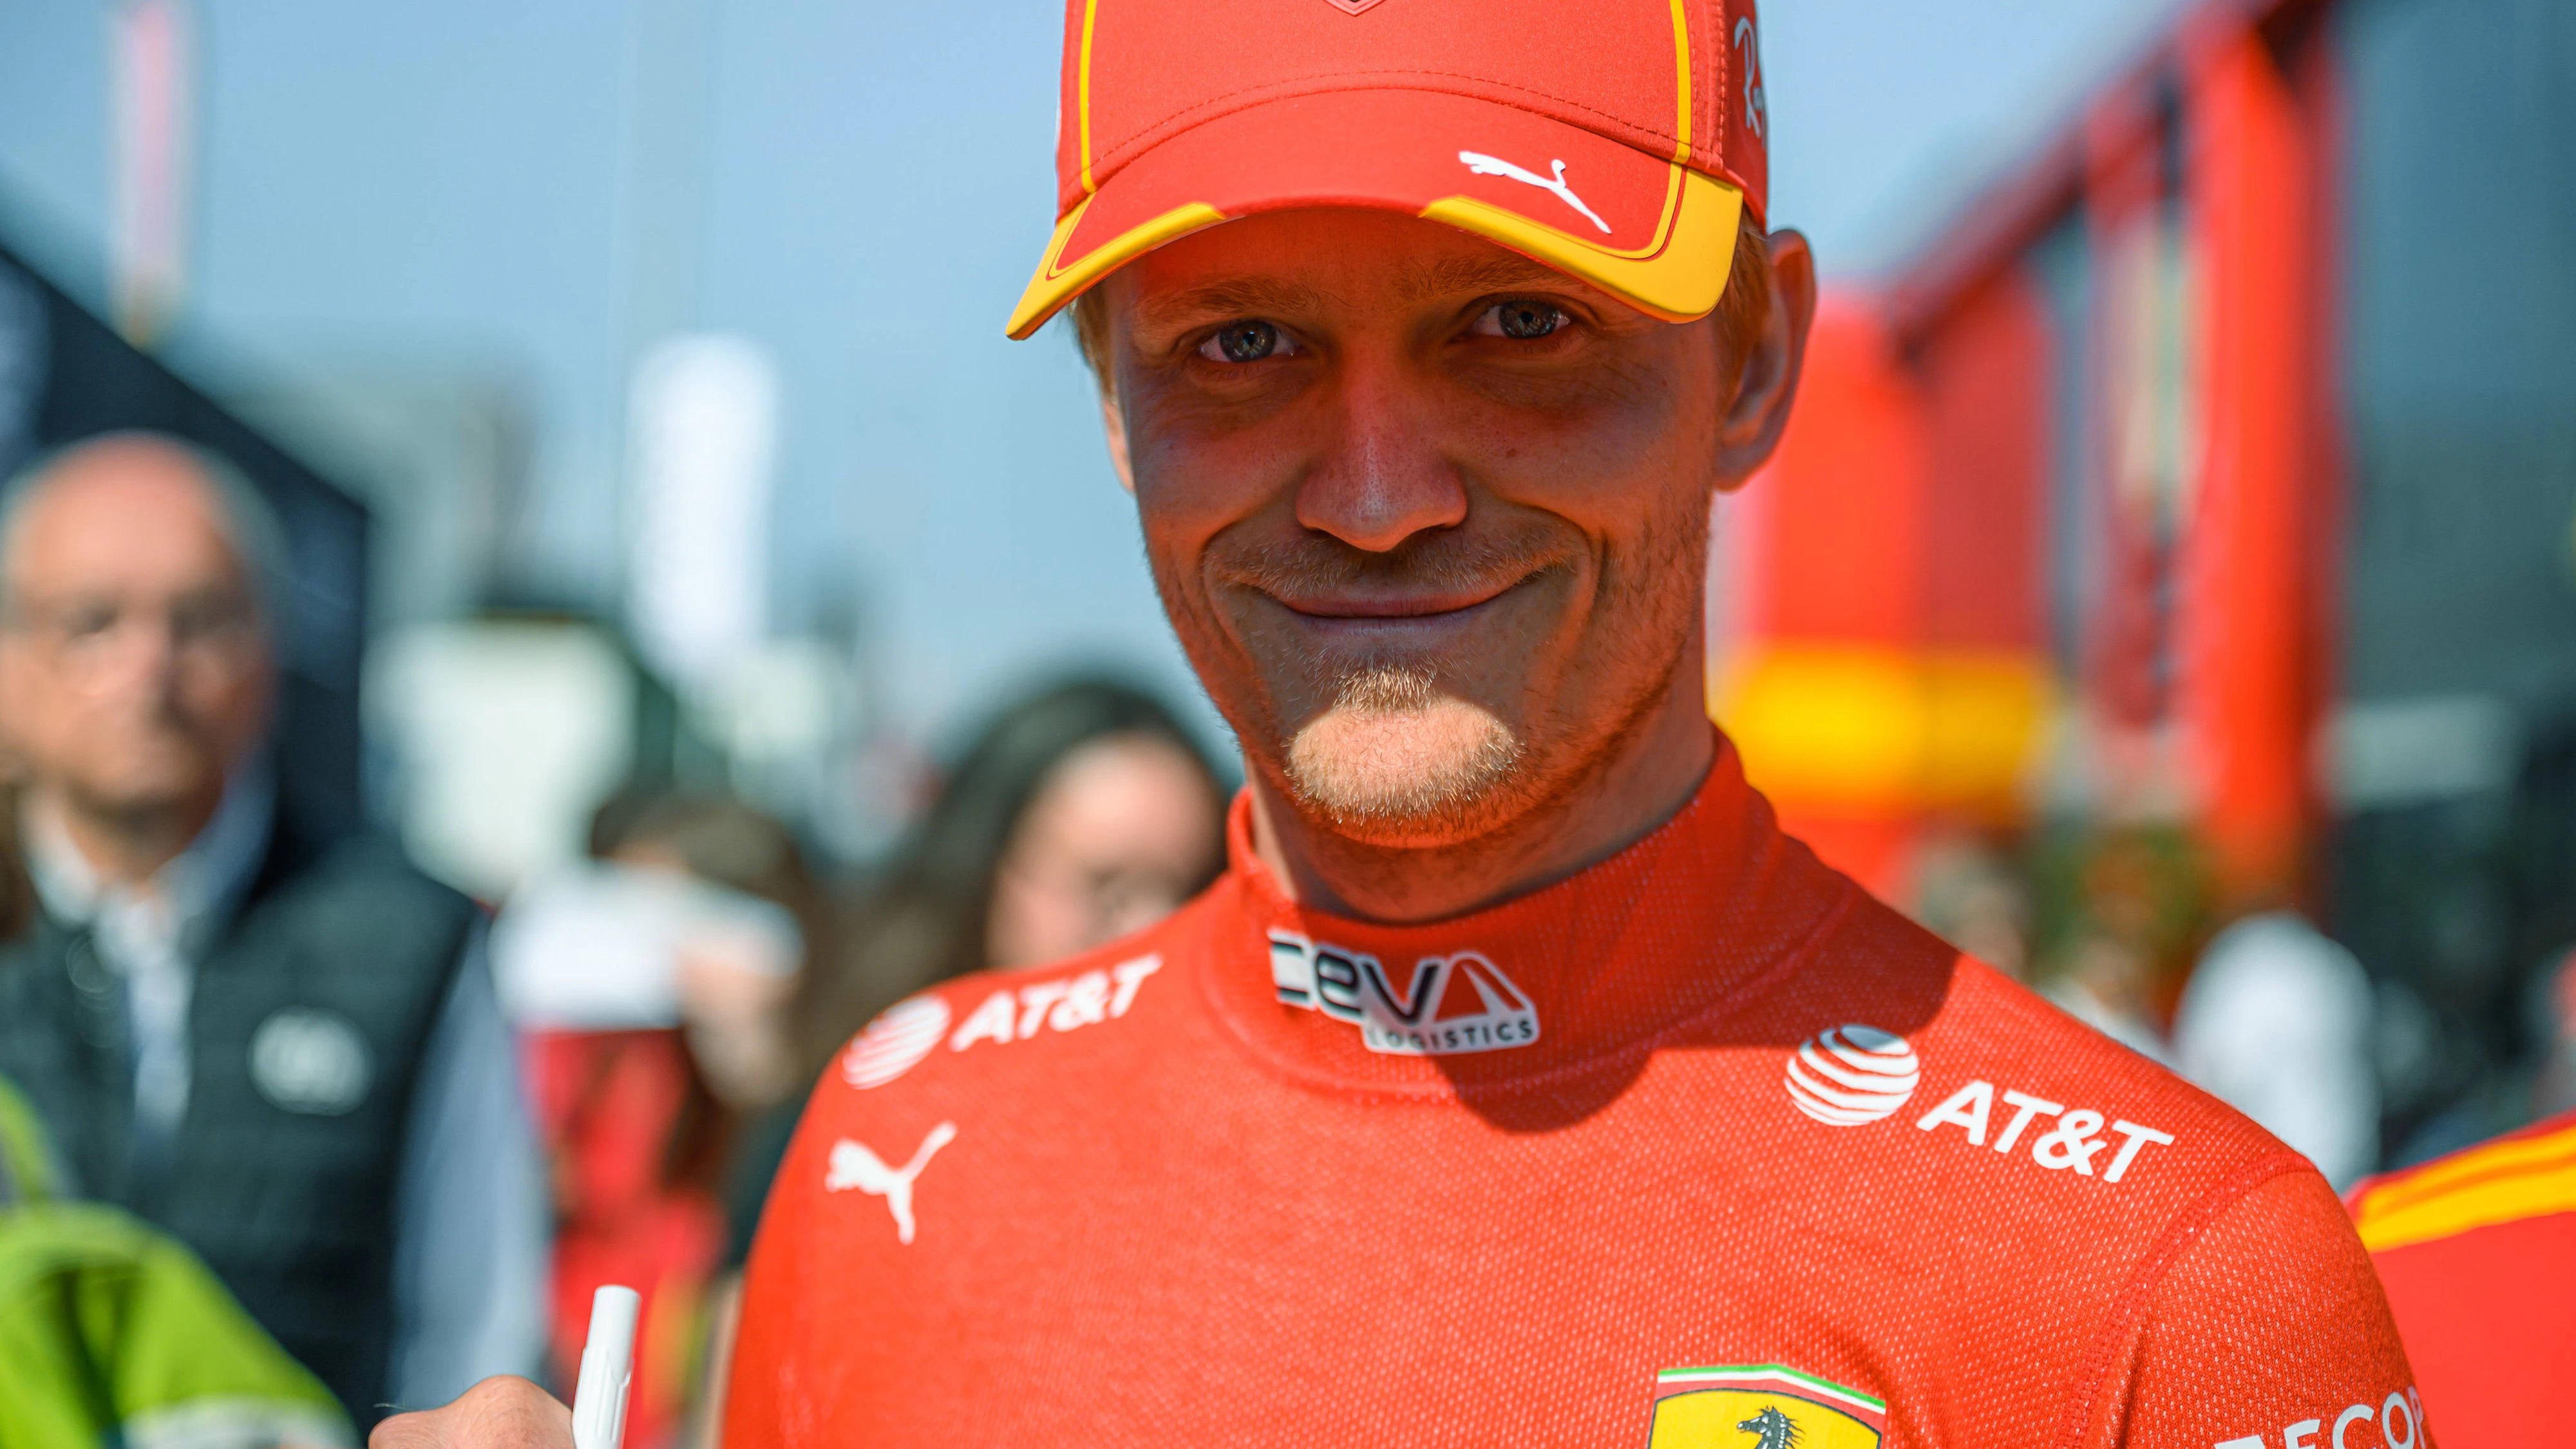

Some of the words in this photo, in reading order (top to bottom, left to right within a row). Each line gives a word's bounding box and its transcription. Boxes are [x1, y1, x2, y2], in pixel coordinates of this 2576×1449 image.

[949, 952, 1164, 1052] AT&T
[1369, 1019, 1533, 1050] LOGISTICS
[1916, 1080, 2174, 1184] AT&T
